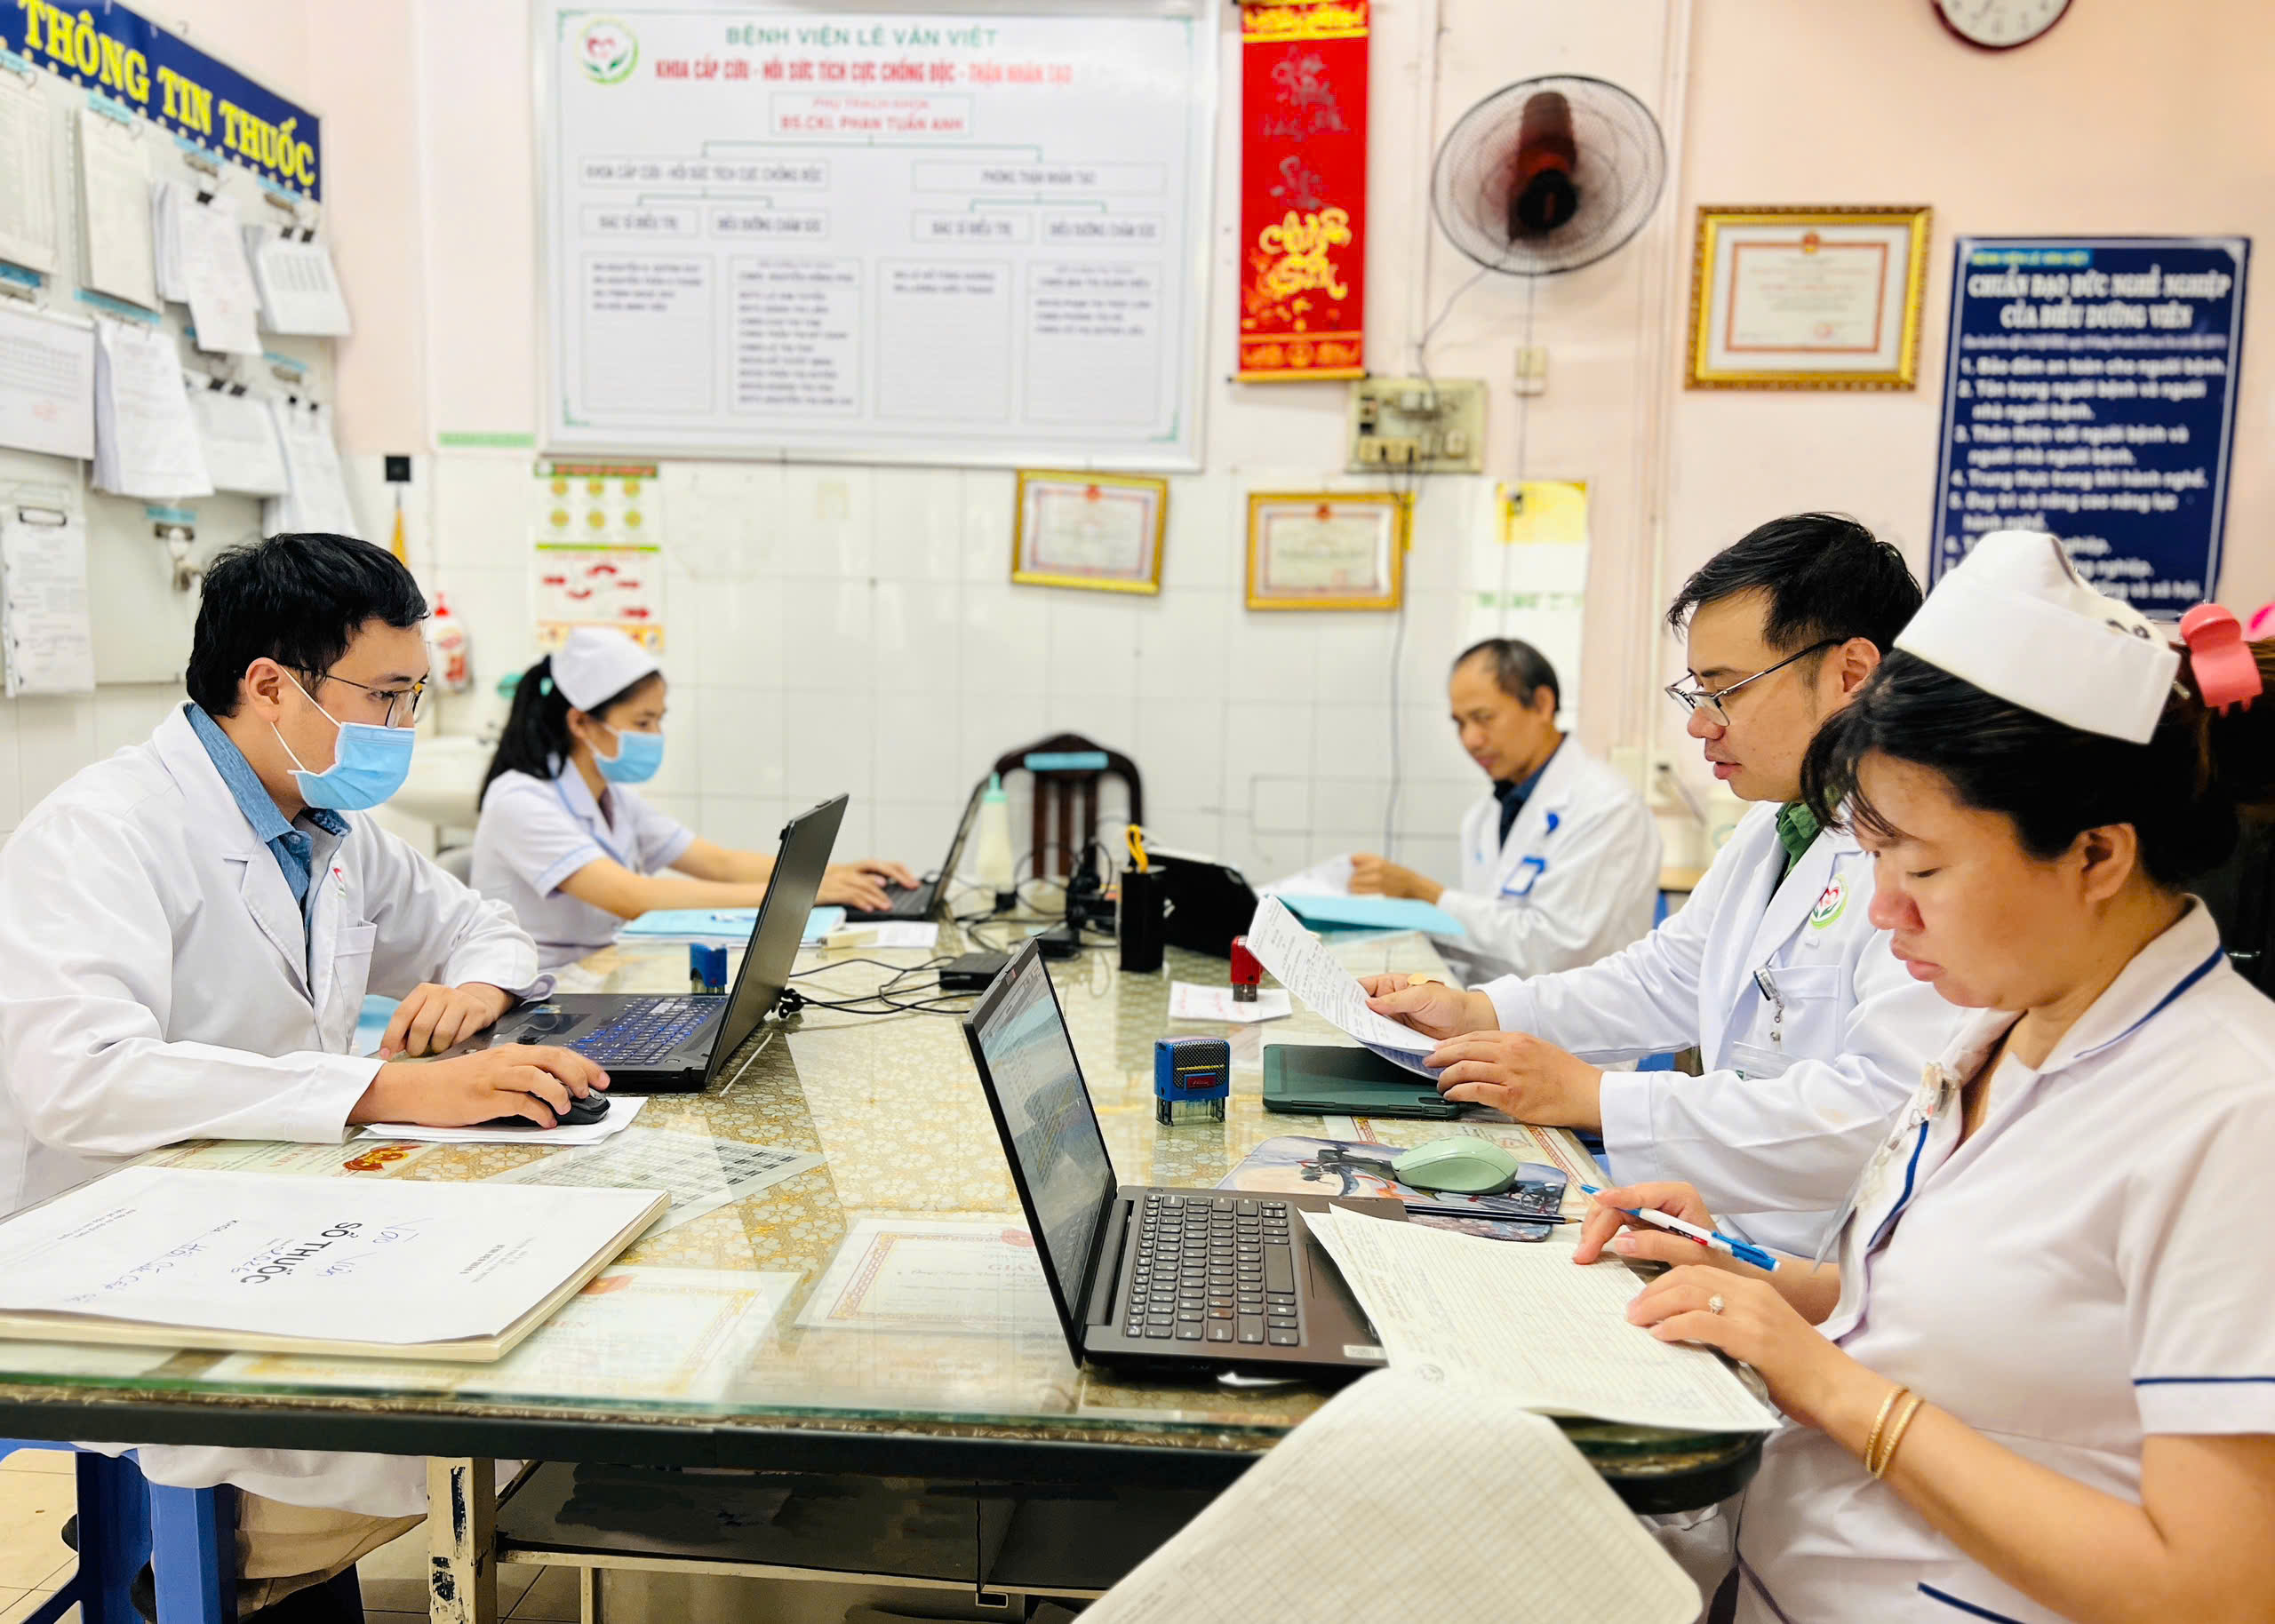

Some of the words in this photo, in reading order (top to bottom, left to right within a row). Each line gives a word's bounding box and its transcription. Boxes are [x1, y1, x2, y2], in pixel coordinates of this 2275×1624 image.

[726, 25, 789, 46] BỆNH
[798, 25, 850, 47] VIỆN
[856, 25, 883, 45] LÊ
[892, 25, 939, 45] VĂN
[946, 25, 996, 47] VIỆT
[17, 0, 151, 104] THÔNG
[157, 65, 212, 135] TIN
[219, 100, 315, 187] THUỐC
[1968, 264, 2030, 298] CHUẨN
[2030, 273, 2070, 301] ĐẠO
[2070, 268, 2110, 298] ĐỨC
[2110, 263, 2161, 298] NGHỀ
[2162, 269, 2231, 302] NGHIỆP
[2000, 299, 2039, 329] CỦA
[2040, 295, 2084, 329] ĐIỀU
[2084, 299, 2147, 329] DƯỠNG
[2148, 299, 2193, 329] VIÊN
[321, 1222, 363, 1238] SỔ
[240, 1241, 333, 1284] THUỐC
